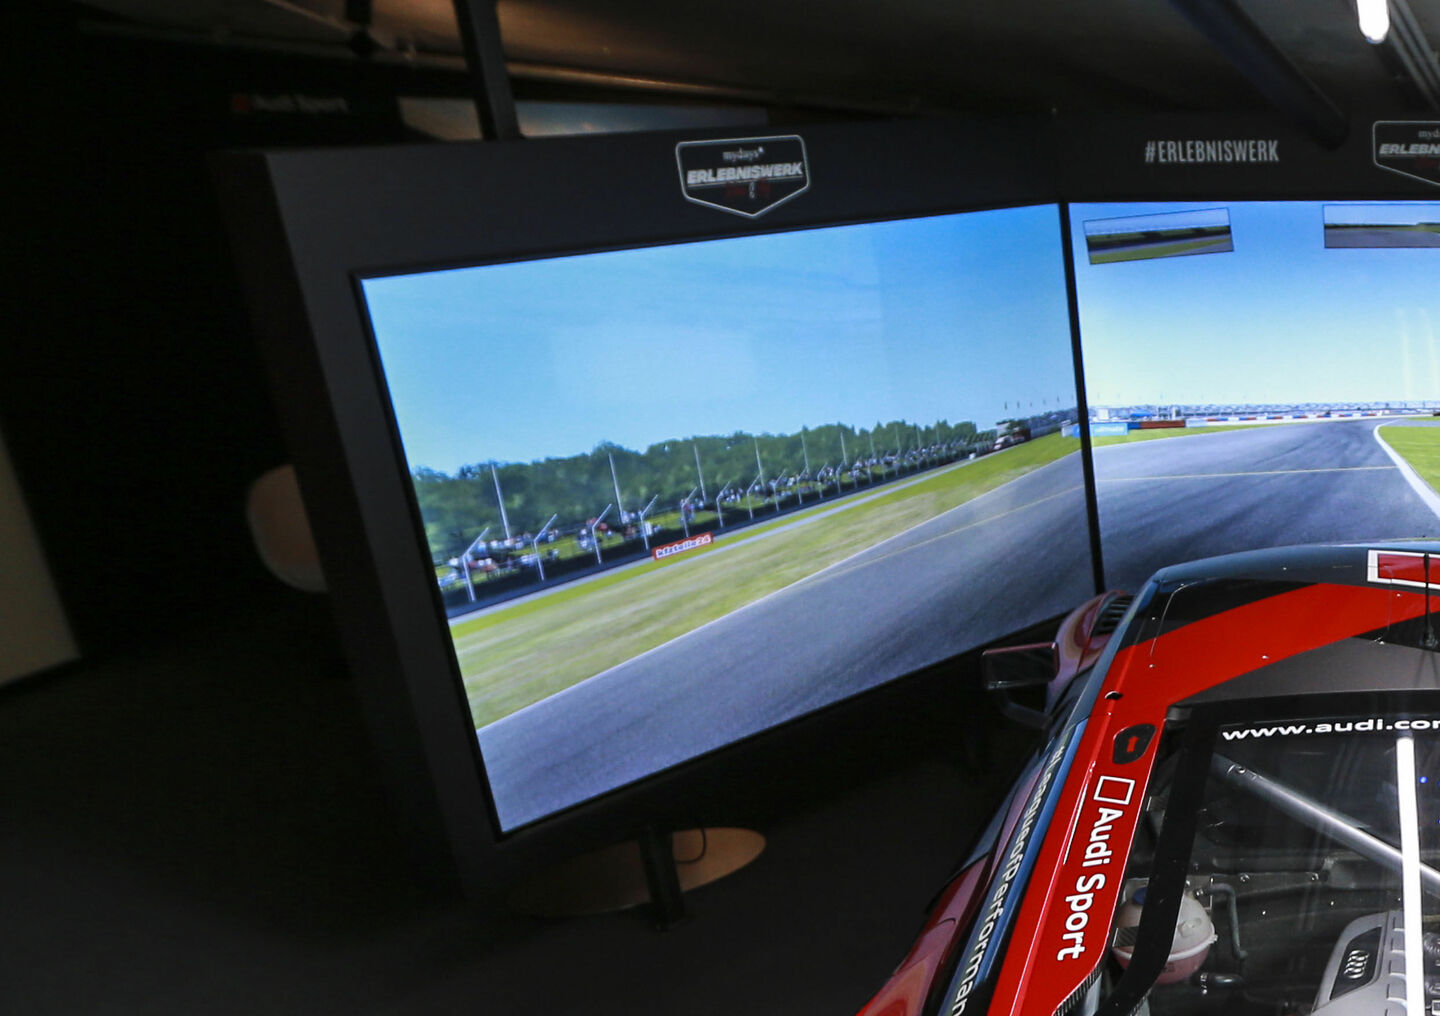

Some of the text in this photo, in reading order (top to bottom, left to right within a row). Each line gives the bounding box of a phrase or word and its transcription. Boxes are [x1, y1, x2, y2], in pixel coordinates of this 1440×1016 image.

[1145, 140, 1280, 163] #ERLEBNISWERK
[687, 162, 803, 184] ERLEBNISWERK
[1057, 807, 1123, 961] Audi Sport
